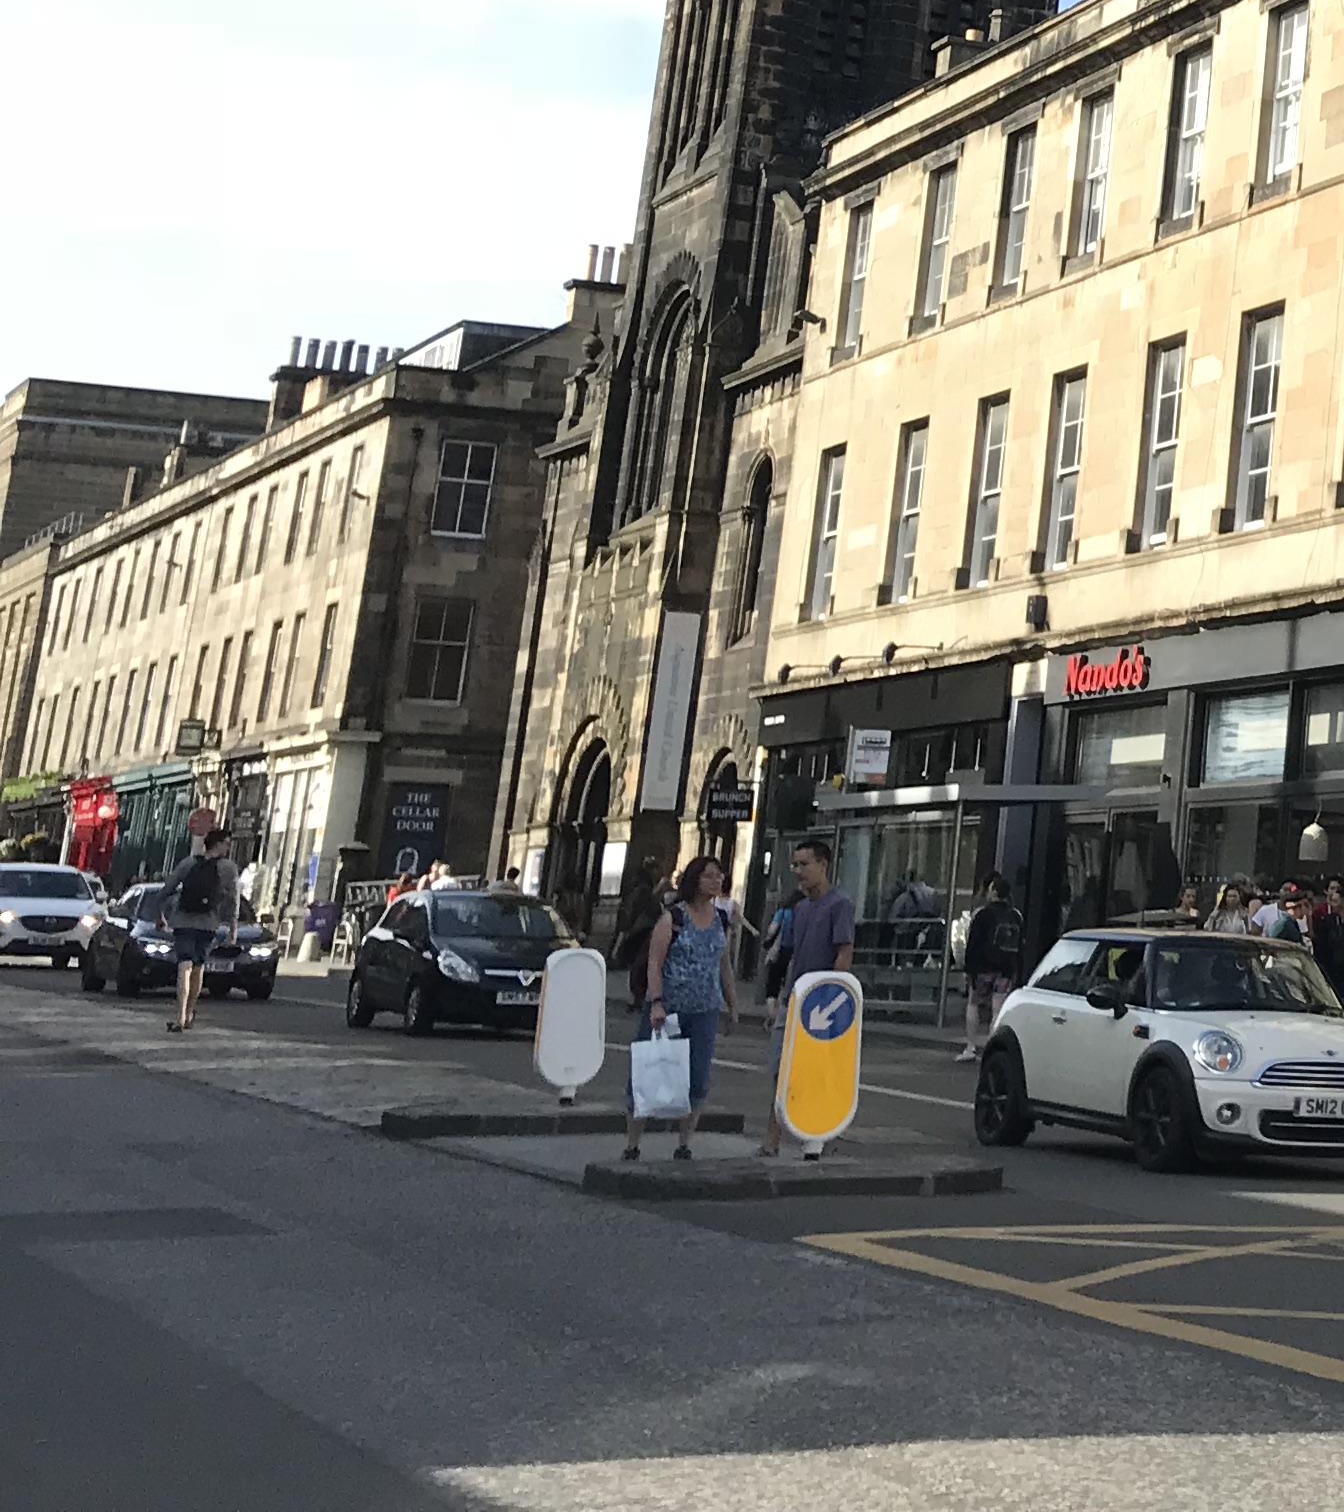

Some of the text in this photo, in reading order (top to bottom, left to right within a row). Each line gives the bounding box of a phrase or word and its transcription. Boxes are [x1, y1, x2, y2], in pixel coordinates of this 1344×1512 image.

[1063, 644, 1144, 695] Nando's
[406, 792, 432, 804] THE
[712, 792, 751, 803] BRUNCH
[392, 806, 440, 817] CELLAR
[396, 819, 434, 831] DOOR
[1306, 1098, 1338, 1115] SM12
